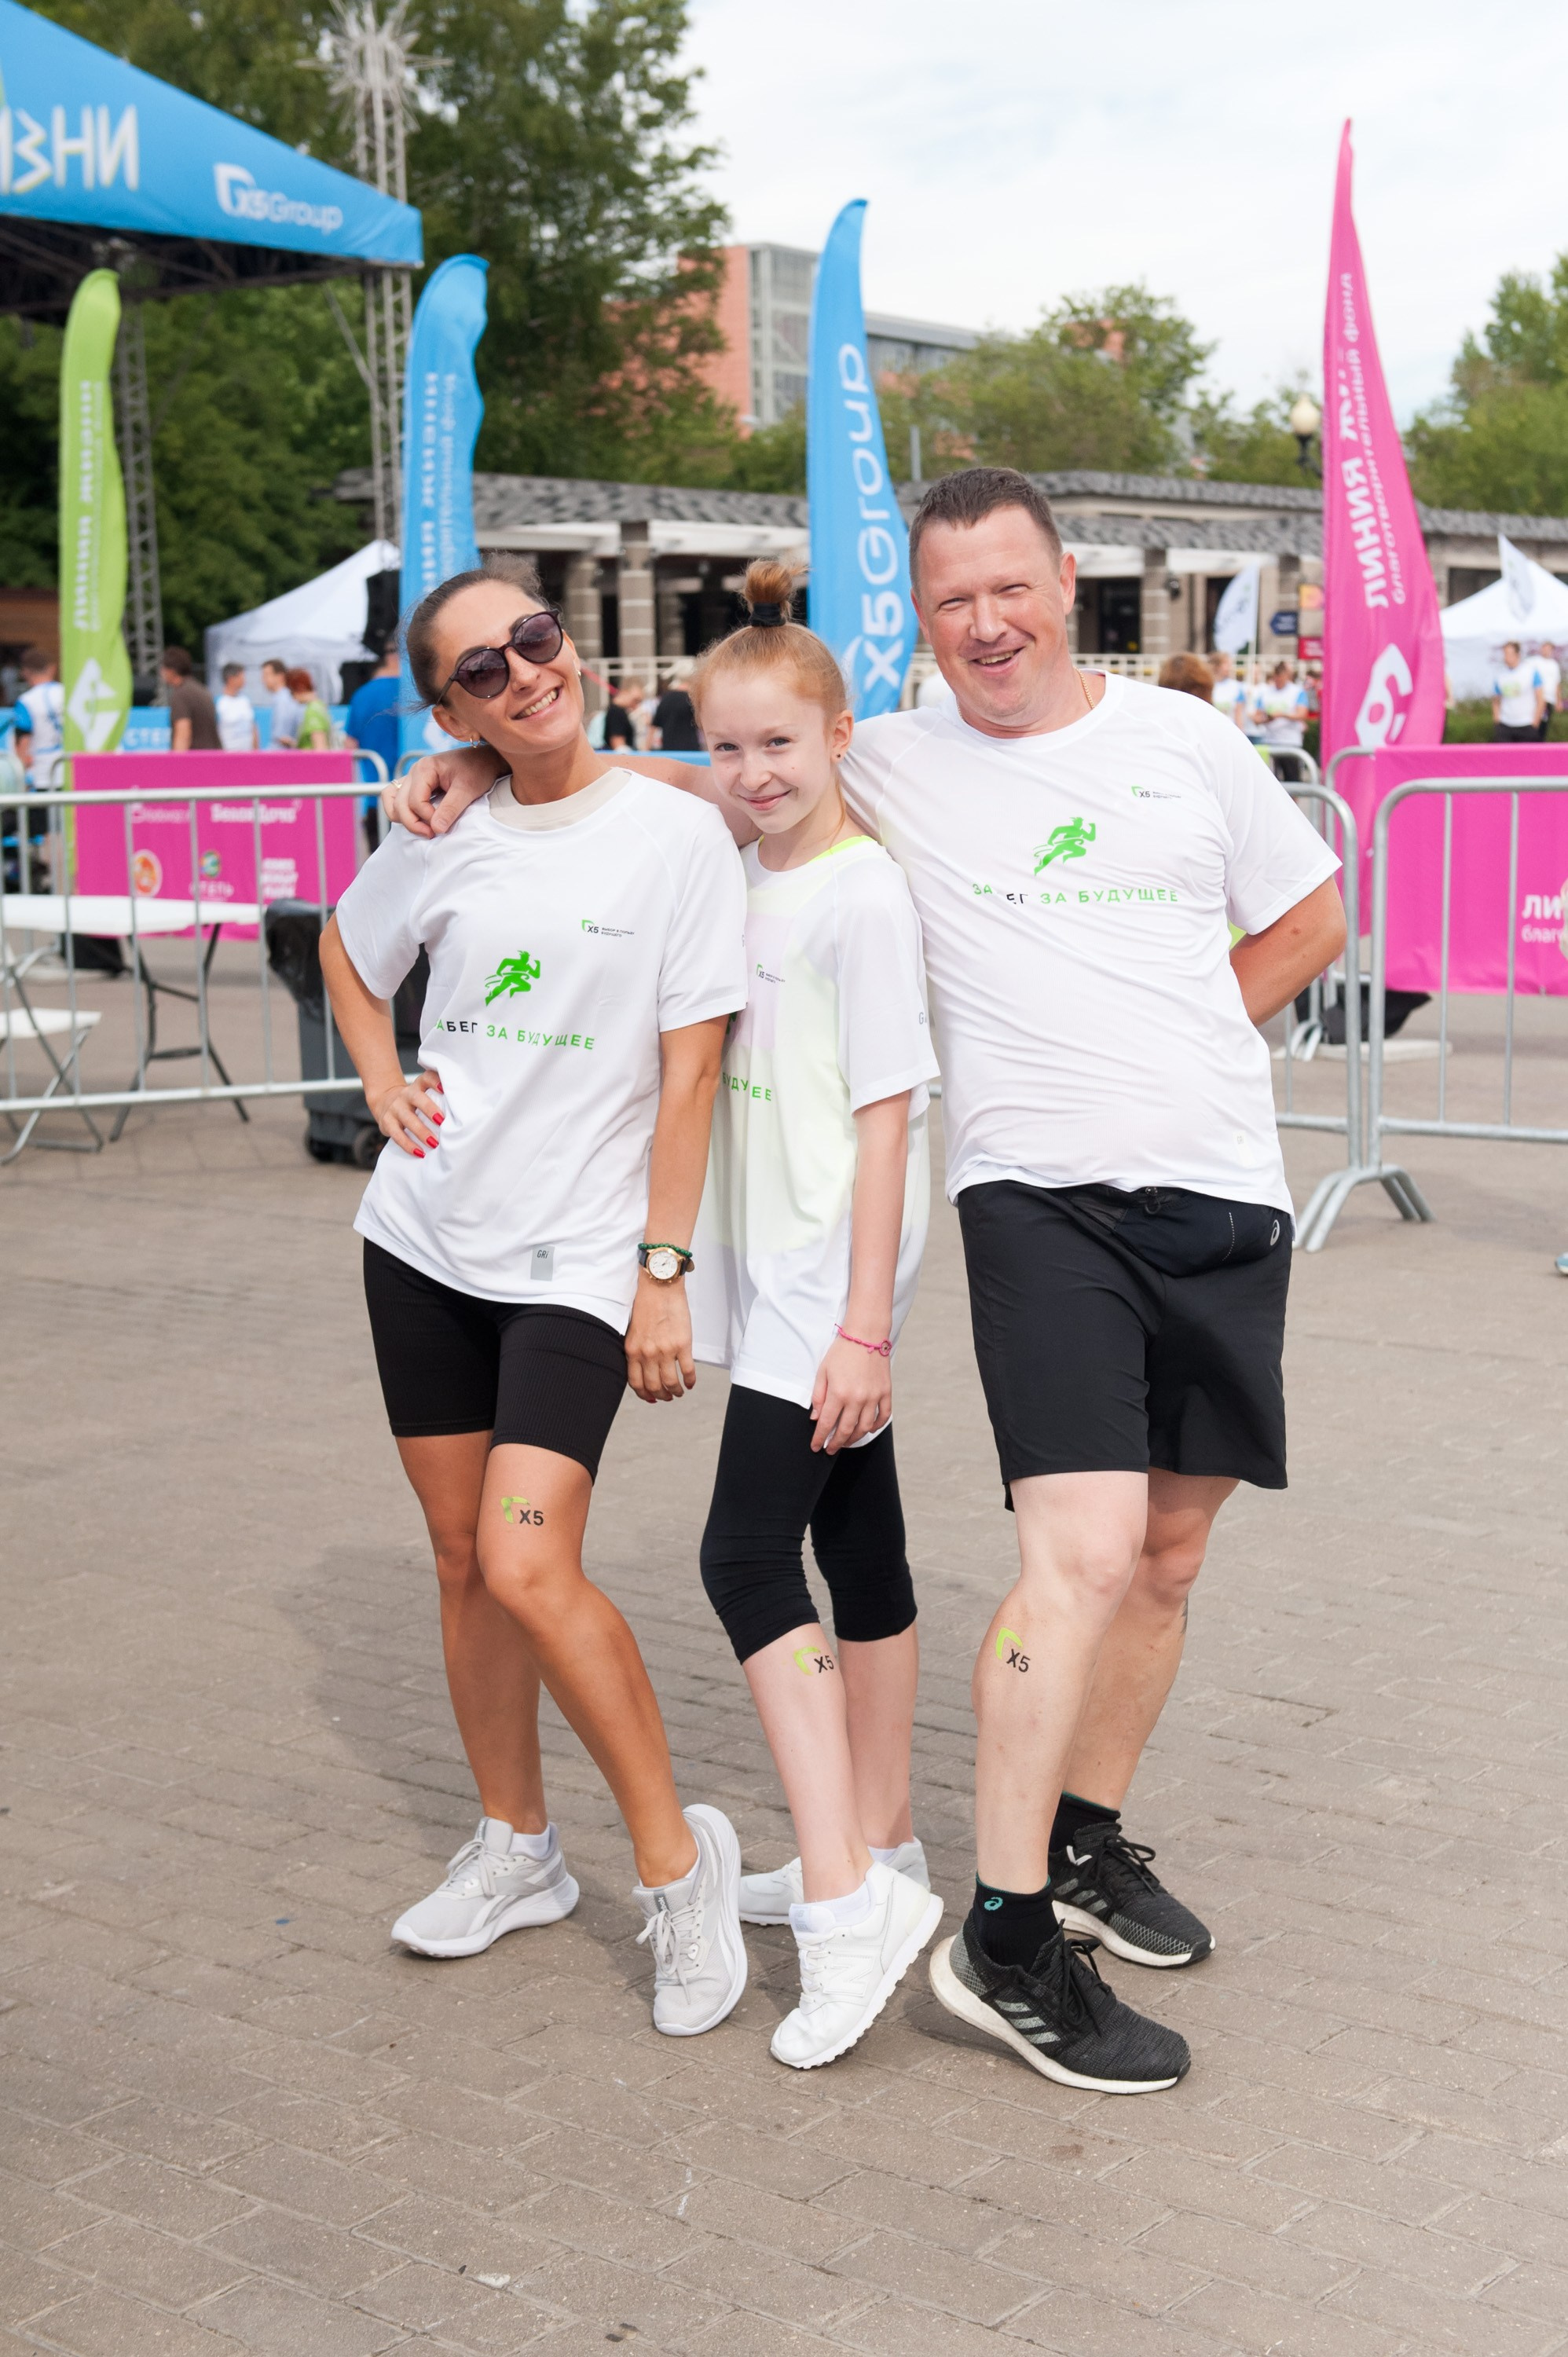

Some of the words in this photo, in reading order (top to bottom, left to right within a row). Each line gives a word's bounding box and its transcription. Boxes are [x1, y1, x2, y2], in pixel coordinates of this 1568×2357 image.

[1341, 456, 1389, 609] ЛИНИЯ
[1040, 892, 1067, 904] ЗА
[1078, 889, 1178, 903] БУДУЩЕЕ
[436, 1018, 478, 1034] АБЕГ
[486, 1025, 508, 1040] ЗА
[517, 1029, 595, 1050] БУДУЩЕЕ
[519, 1509, 544, 1527] X5
[813, 1655, 834, 1673] X5
[1006, 1648, 1031, 1673] X5
